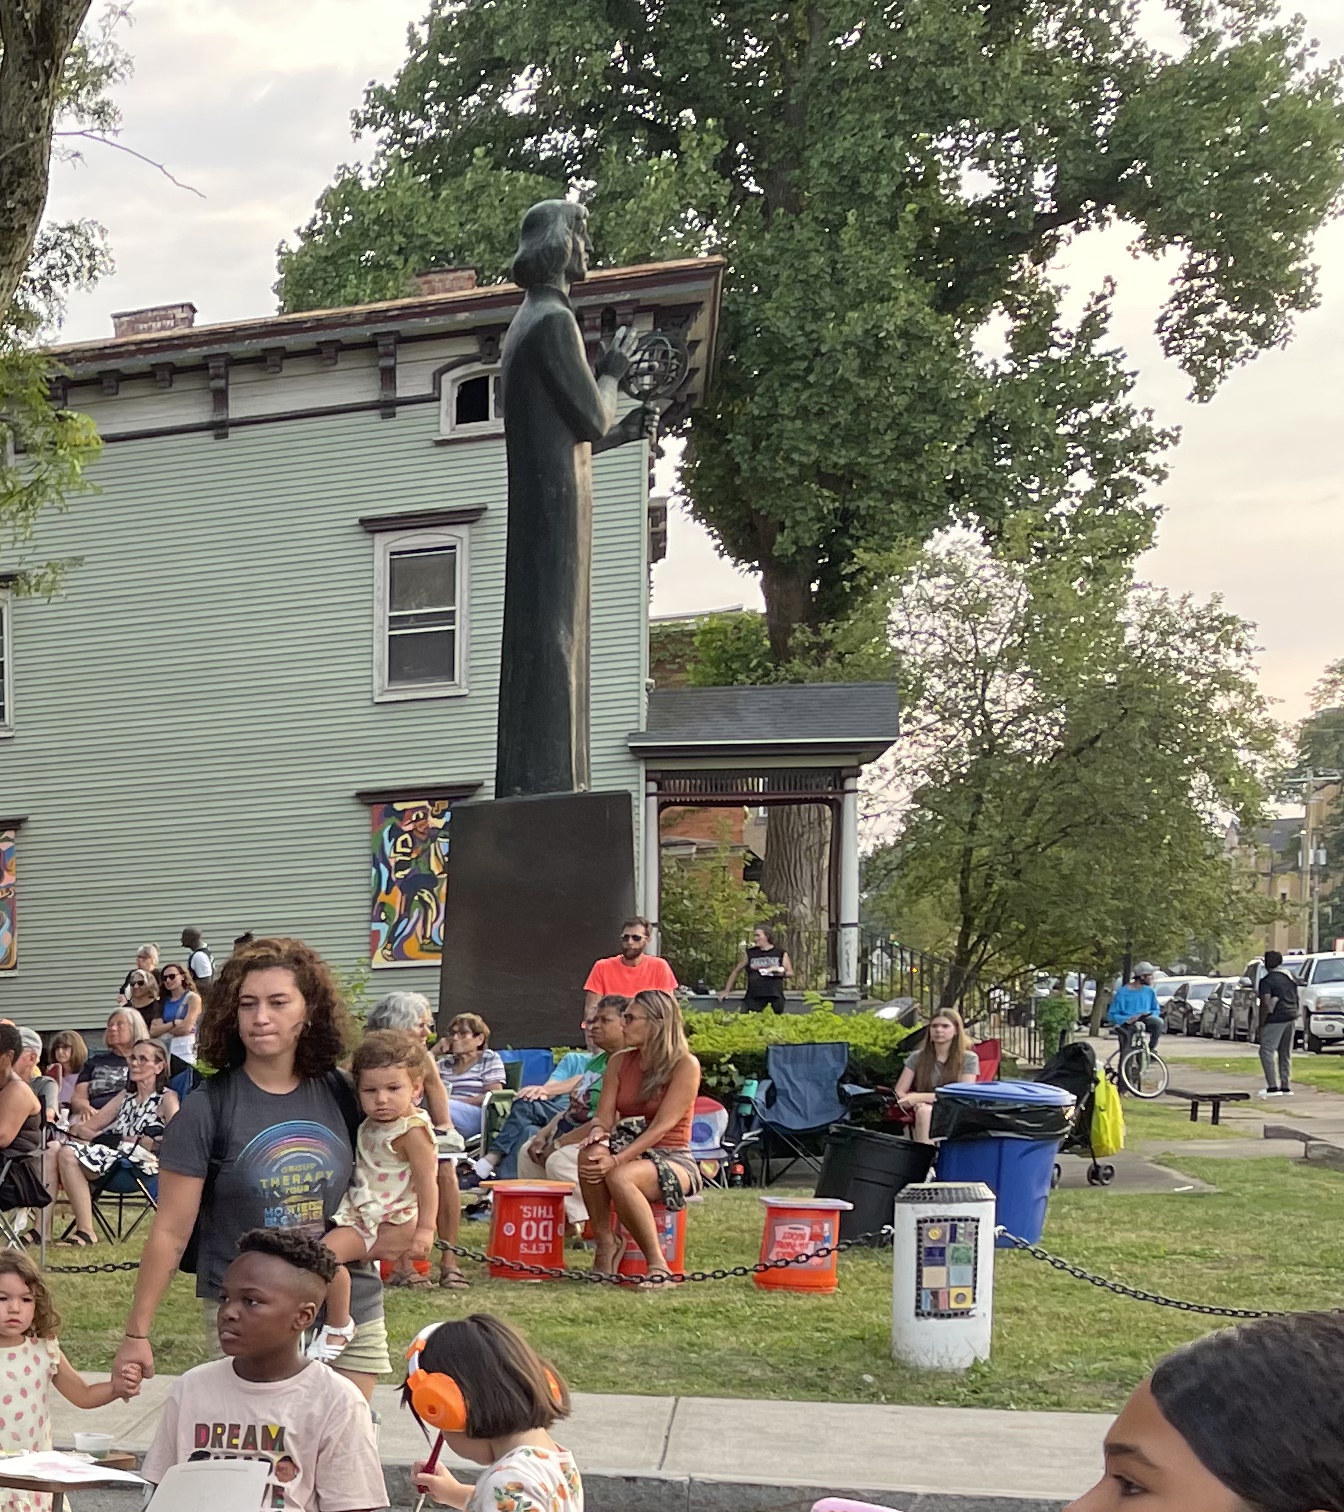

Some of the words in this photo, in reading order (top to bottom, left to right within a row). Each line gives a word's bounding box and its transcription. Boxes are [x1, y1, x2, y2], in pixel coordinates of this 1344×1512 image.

[260, 1170, 334, 1189] THERAPY
[521, 1220, 554, 1241] DO
[194, 1422, 286, 1452] DREAM
